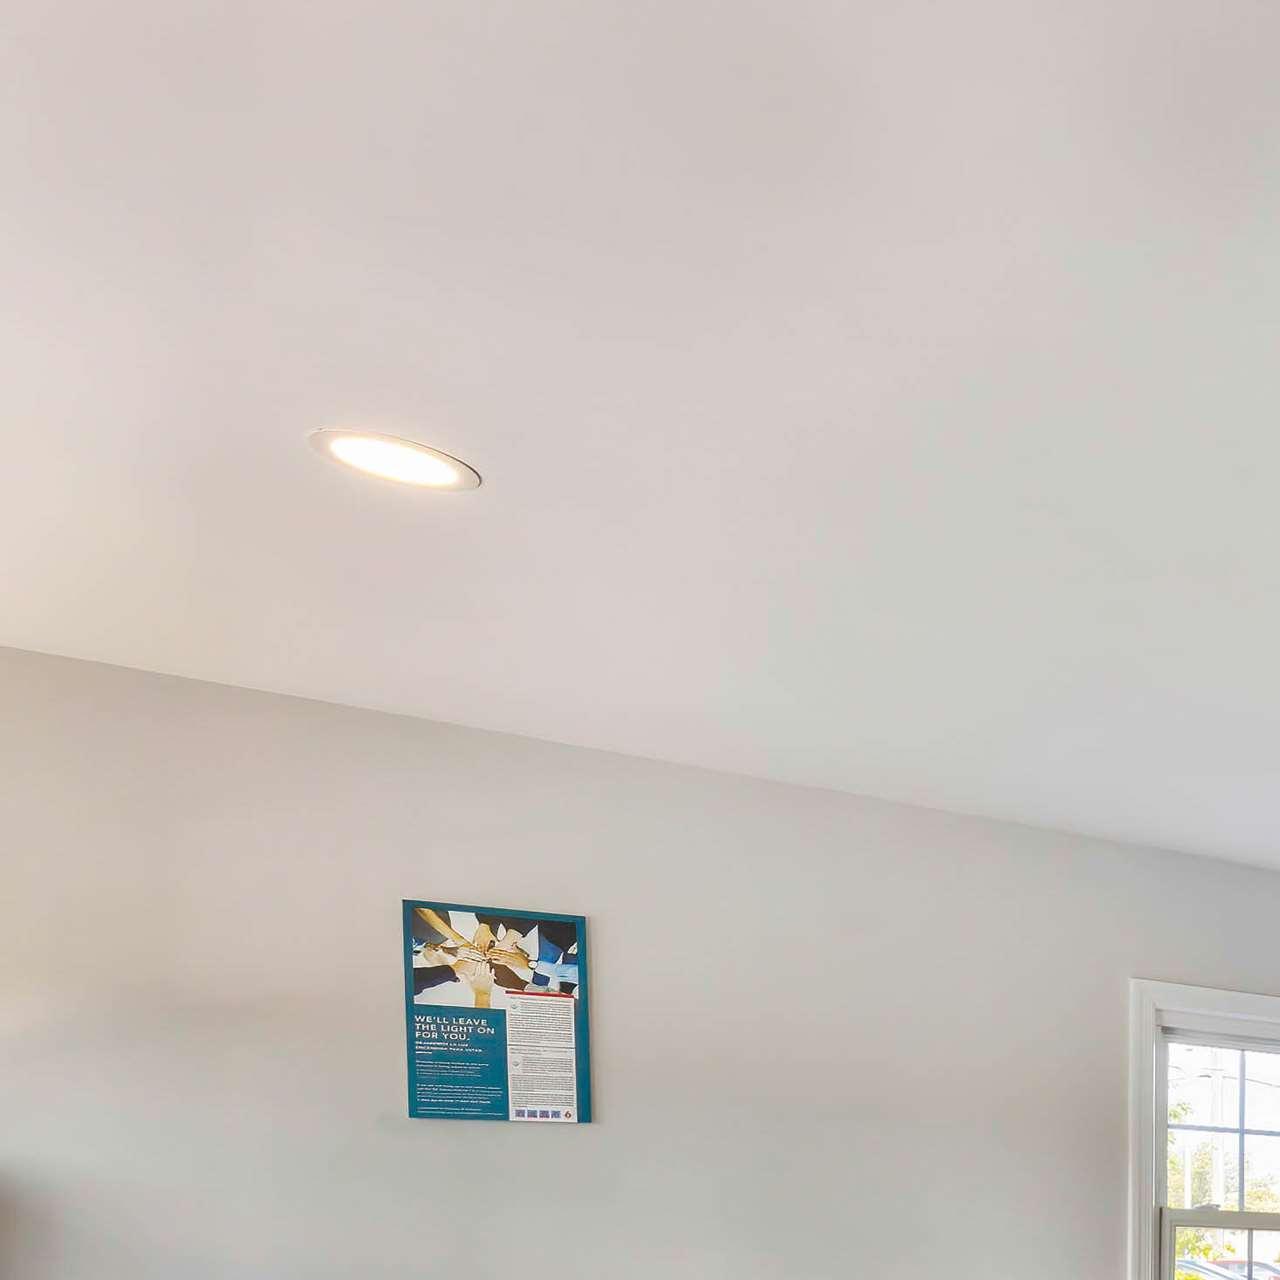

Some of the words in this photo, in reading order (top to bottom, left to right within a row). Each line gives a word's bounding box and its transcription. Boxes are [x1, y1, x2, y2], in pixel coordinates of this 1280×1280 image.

[414, 1015, 449, 1023] WE'LL
[453, 1018, 487, 1026] LEAVE
[415, 1023, 437, 1031] THE
[441, 1025, 474, 1033] LIGHT
[415, 1031, 438, 1039] FOR
